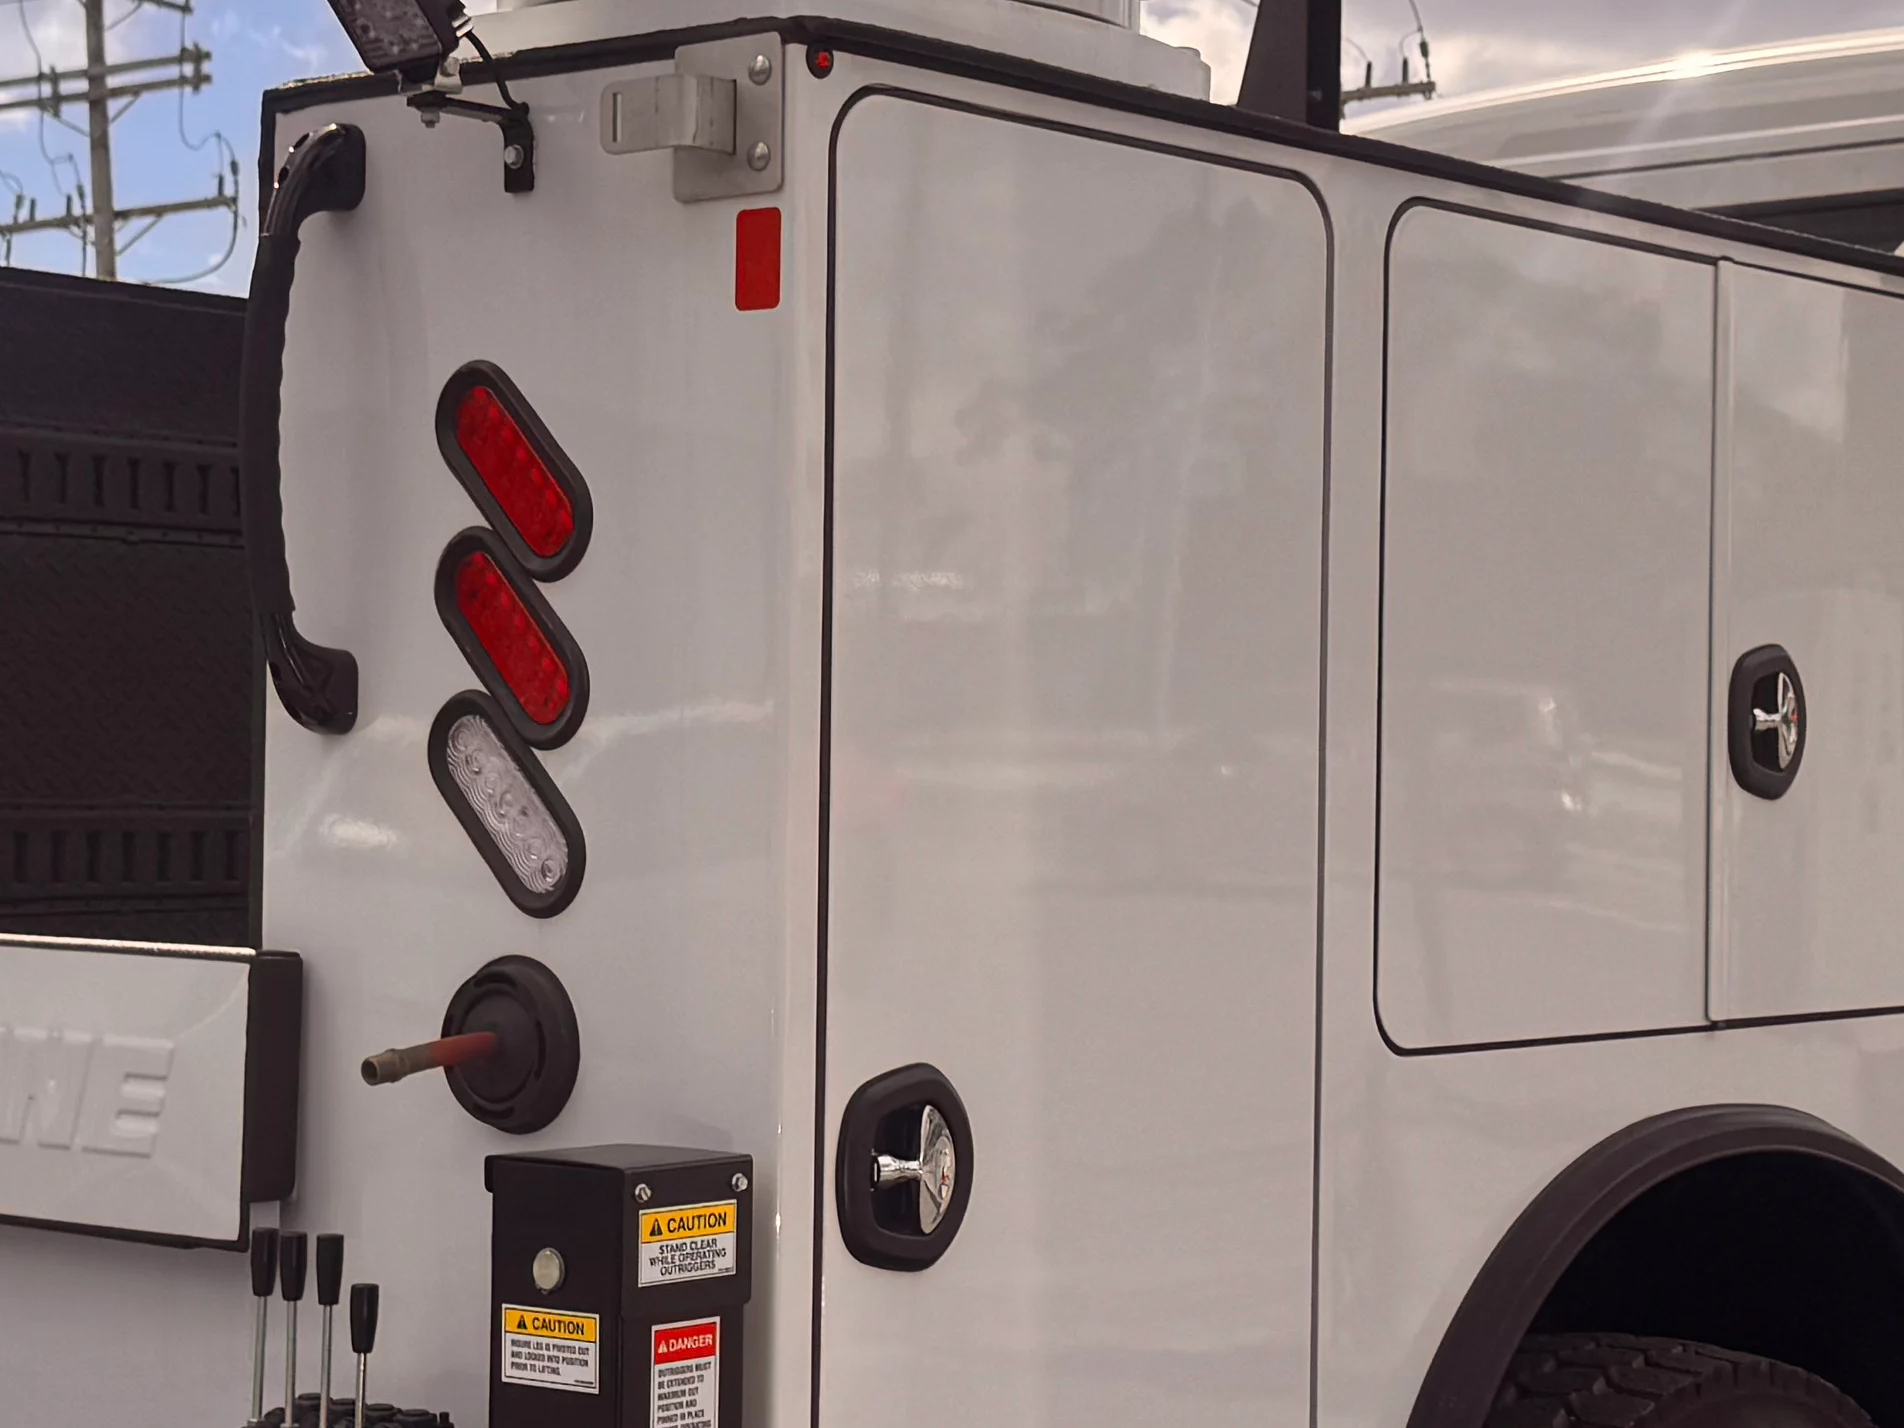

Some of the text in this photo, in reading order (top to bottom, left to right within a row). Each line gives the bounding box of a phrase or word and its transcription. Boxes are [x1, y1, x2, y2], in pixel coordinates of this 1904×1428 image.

[667, 1211, 727, 1233] CAUTION
[659, 1238, 718, 1255] STAND CLEAR
[649, 1248, 727, 1267] WHILE OPERATING
[660, 1260, 716, 1276] OUTRIGGERS
[532, 1317, 585, 1335] CAUTION
[669, 1334, 713, 1352] DANGER
